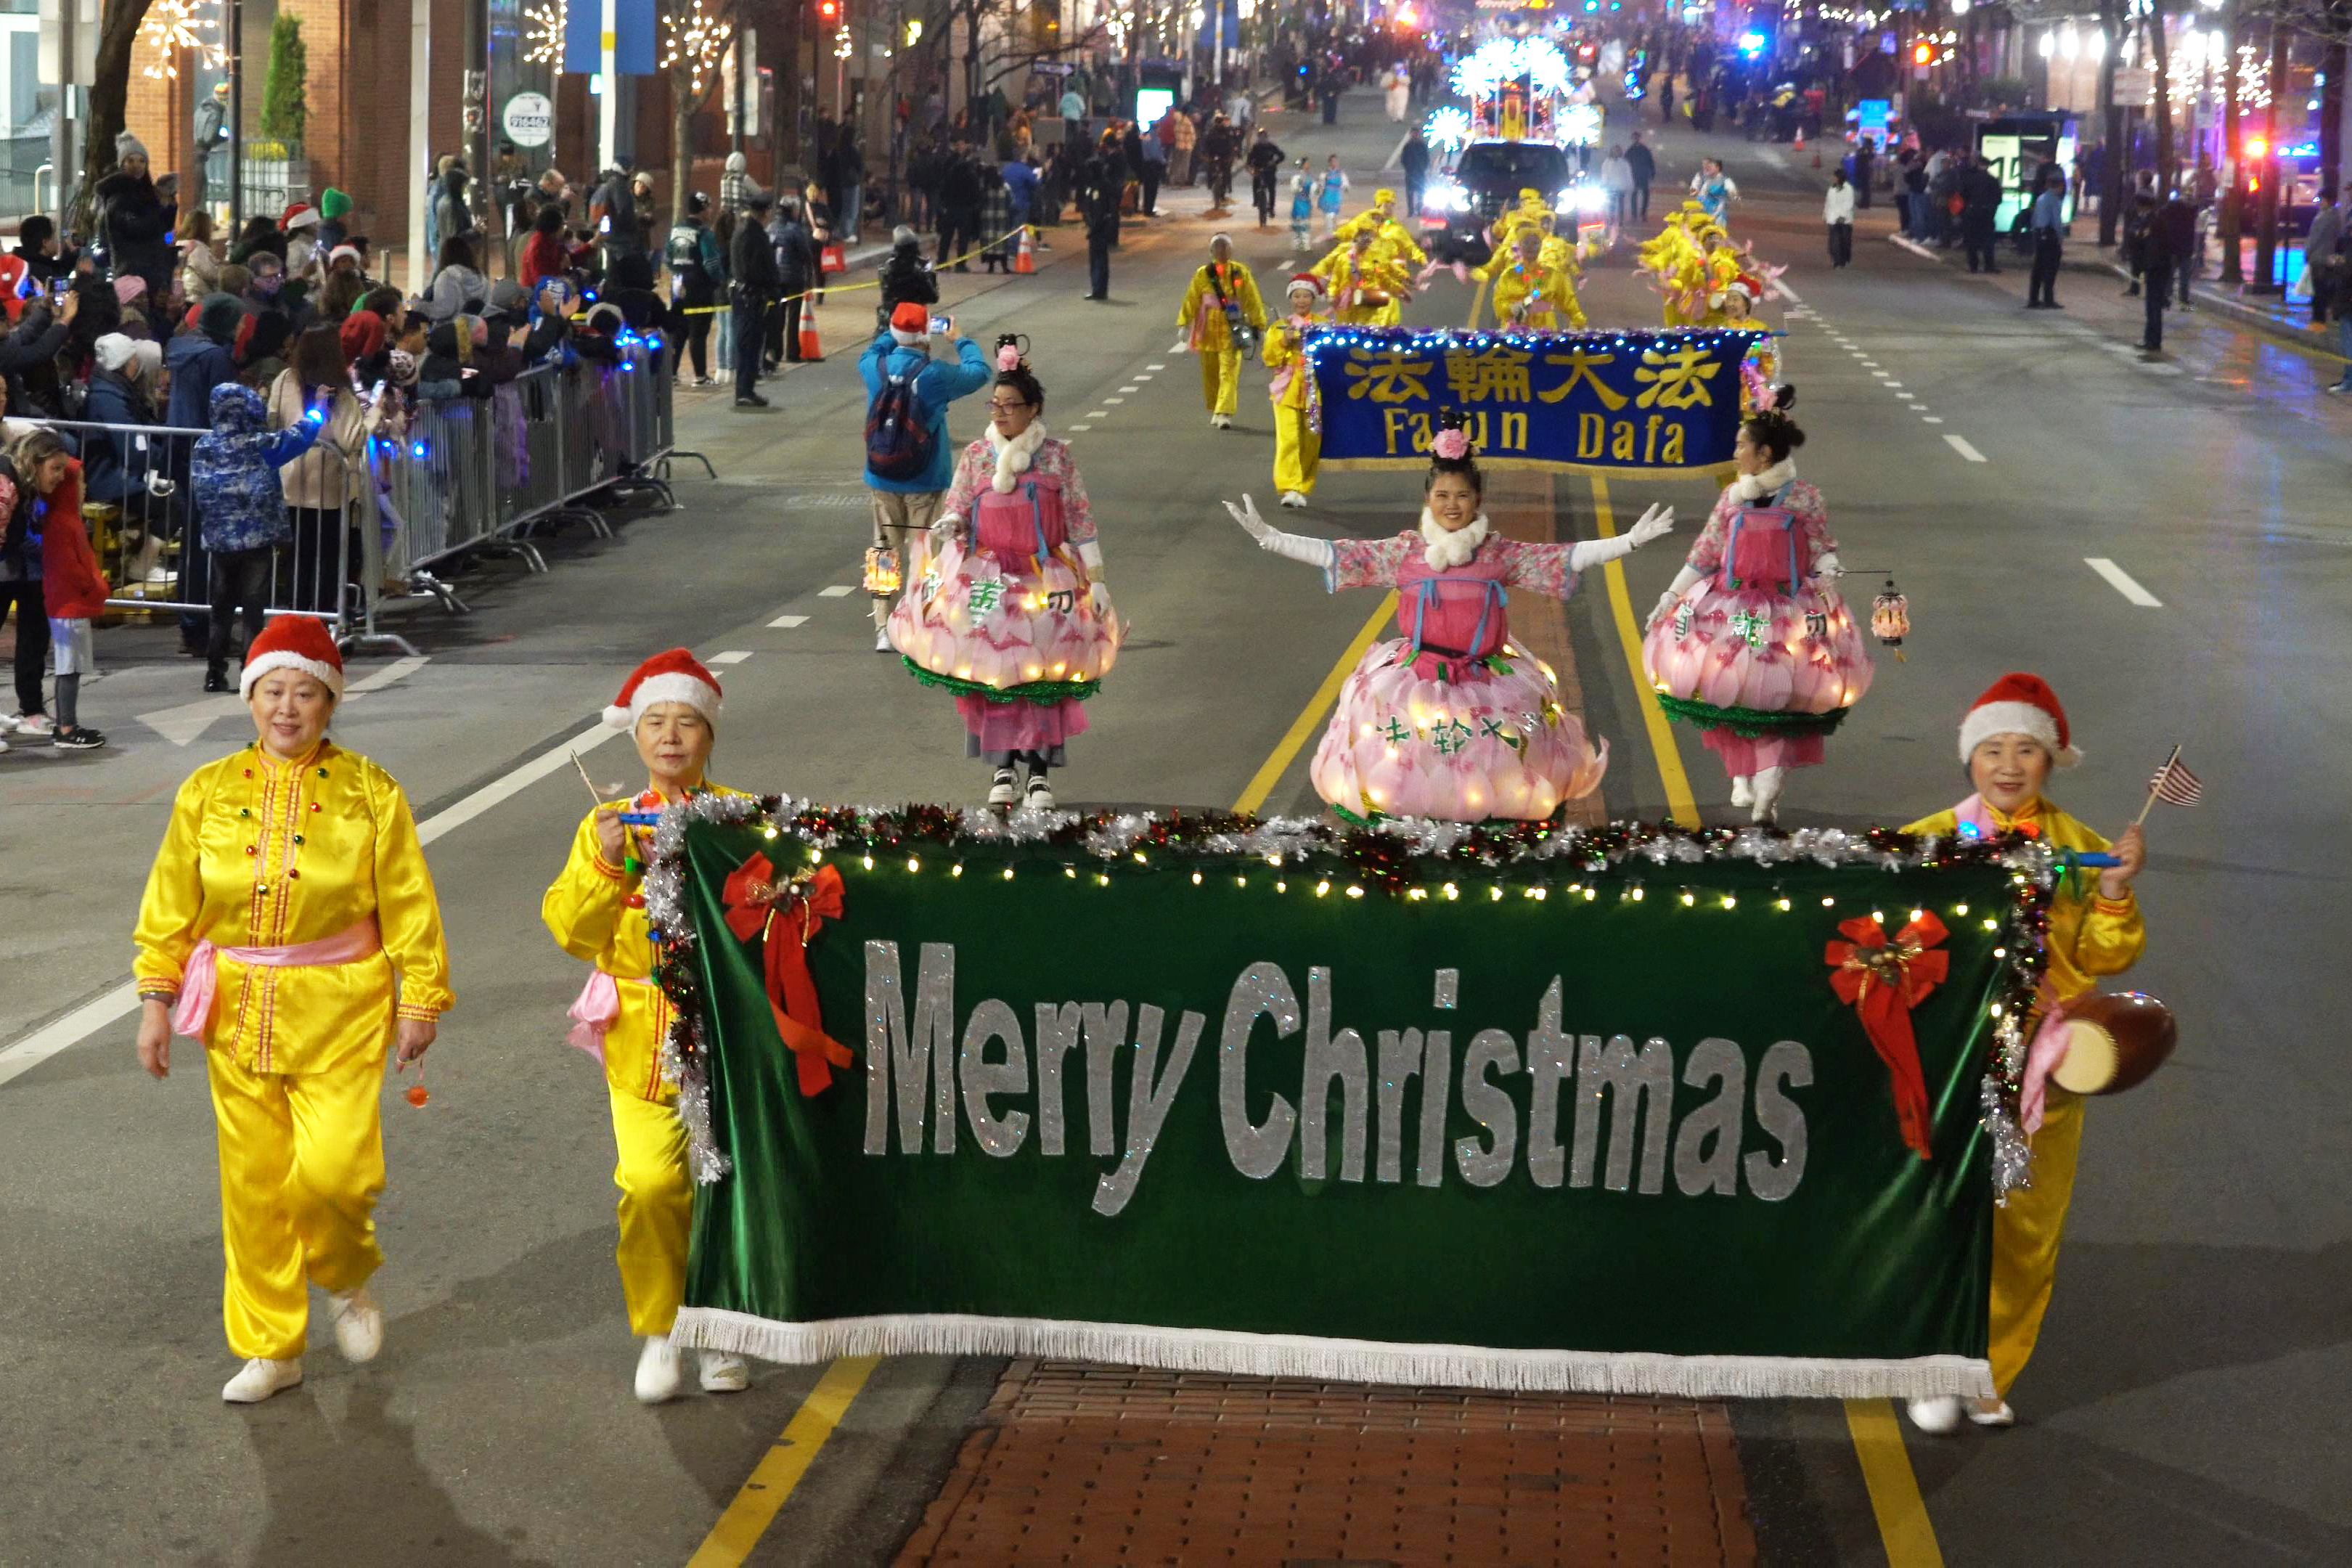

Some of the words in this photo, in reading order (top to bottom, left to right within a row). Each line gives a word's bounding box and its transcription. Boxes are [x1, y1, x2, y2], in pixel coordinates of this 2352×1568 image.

[1344, 345, 1721, 410] 法輪大法
[1384, 406, 1528, 454] Faun
[1577, 413, 1684, 463] Dafa
[865, 940, 1205, 1216] Merry
[1220, 962, 1813, 1201] Christmas
